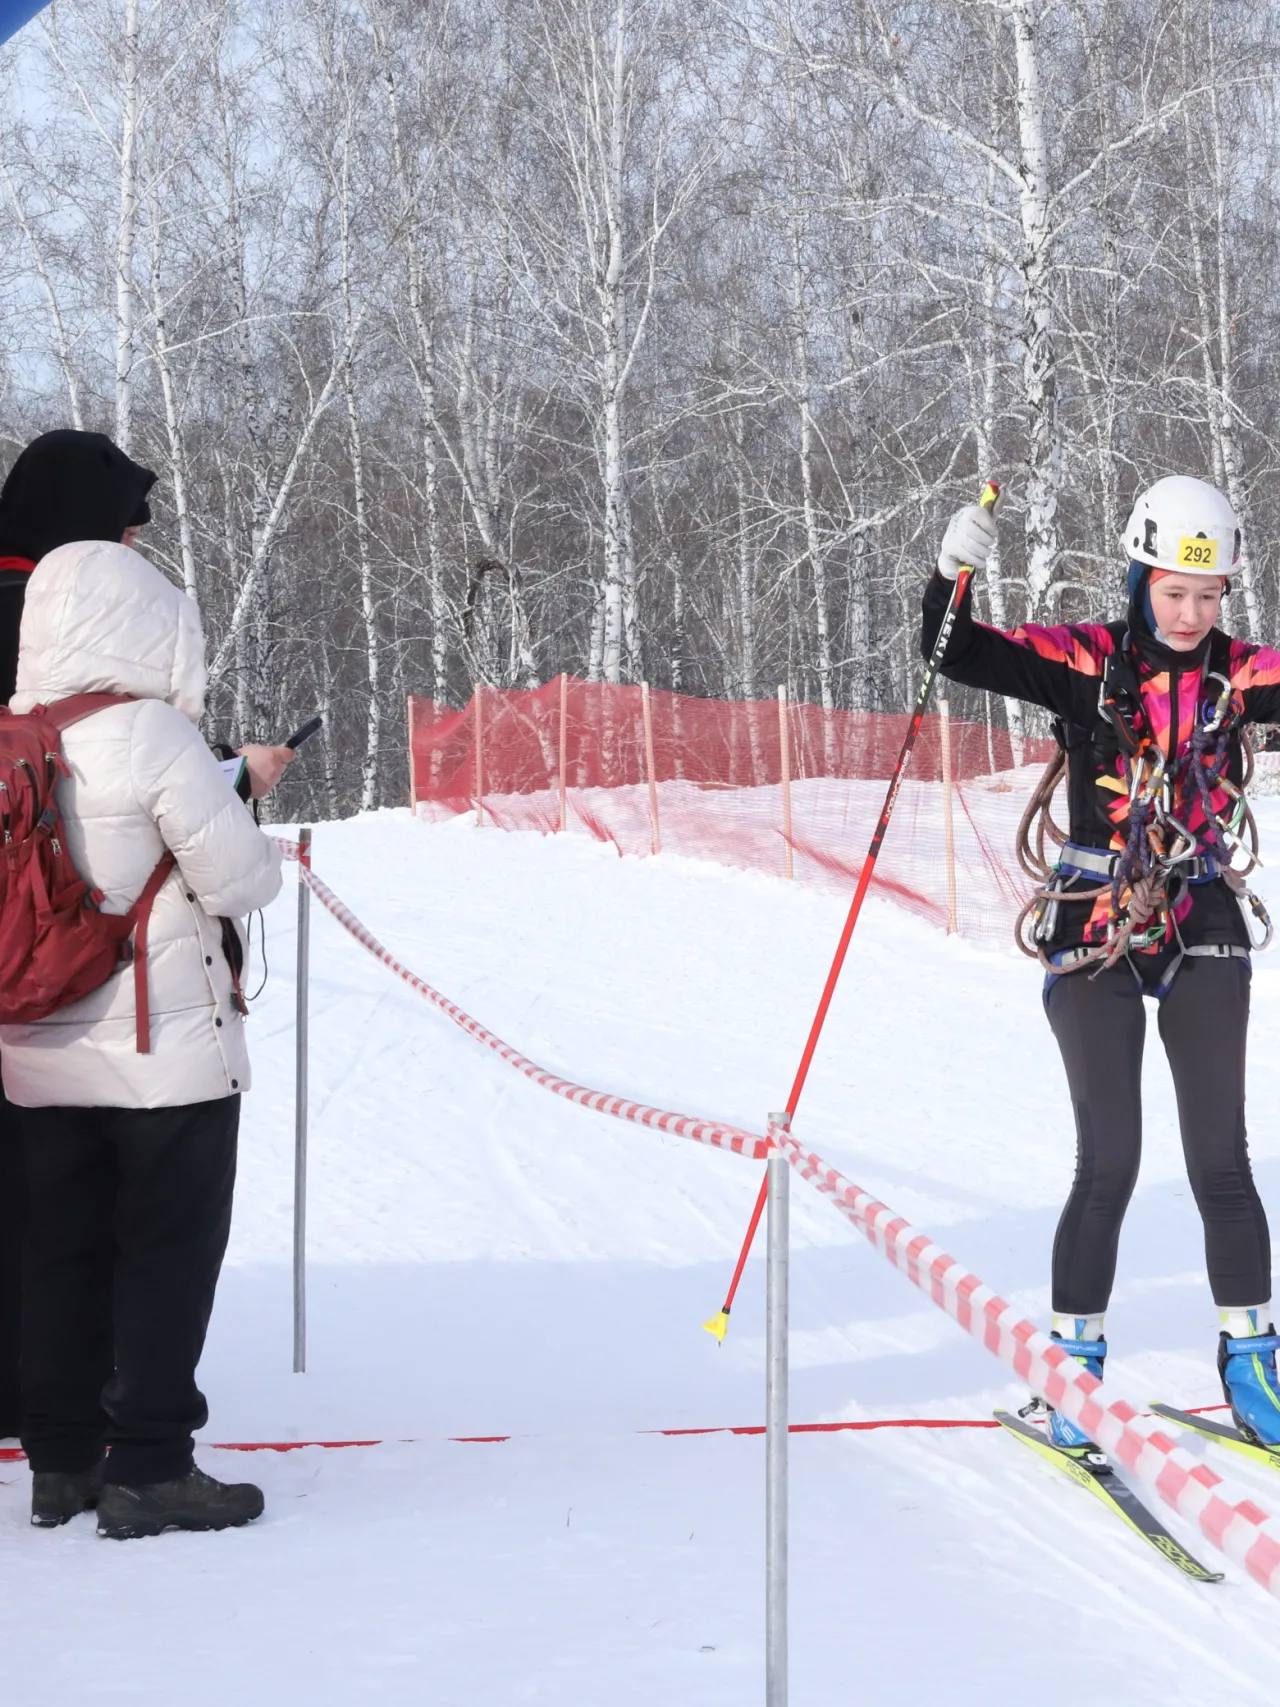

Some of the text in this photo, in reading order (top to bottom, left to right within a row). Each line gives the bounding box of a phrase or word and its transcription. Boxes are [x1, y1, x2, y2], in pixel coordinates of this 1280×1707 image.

[1183, 546, 1212, 563] 292
[935, 612, 956, 658] LEKI
[1065, 1459, 1091, 1484] FISCHER
[1147, 1533, 1209, 1578] FISCHER
